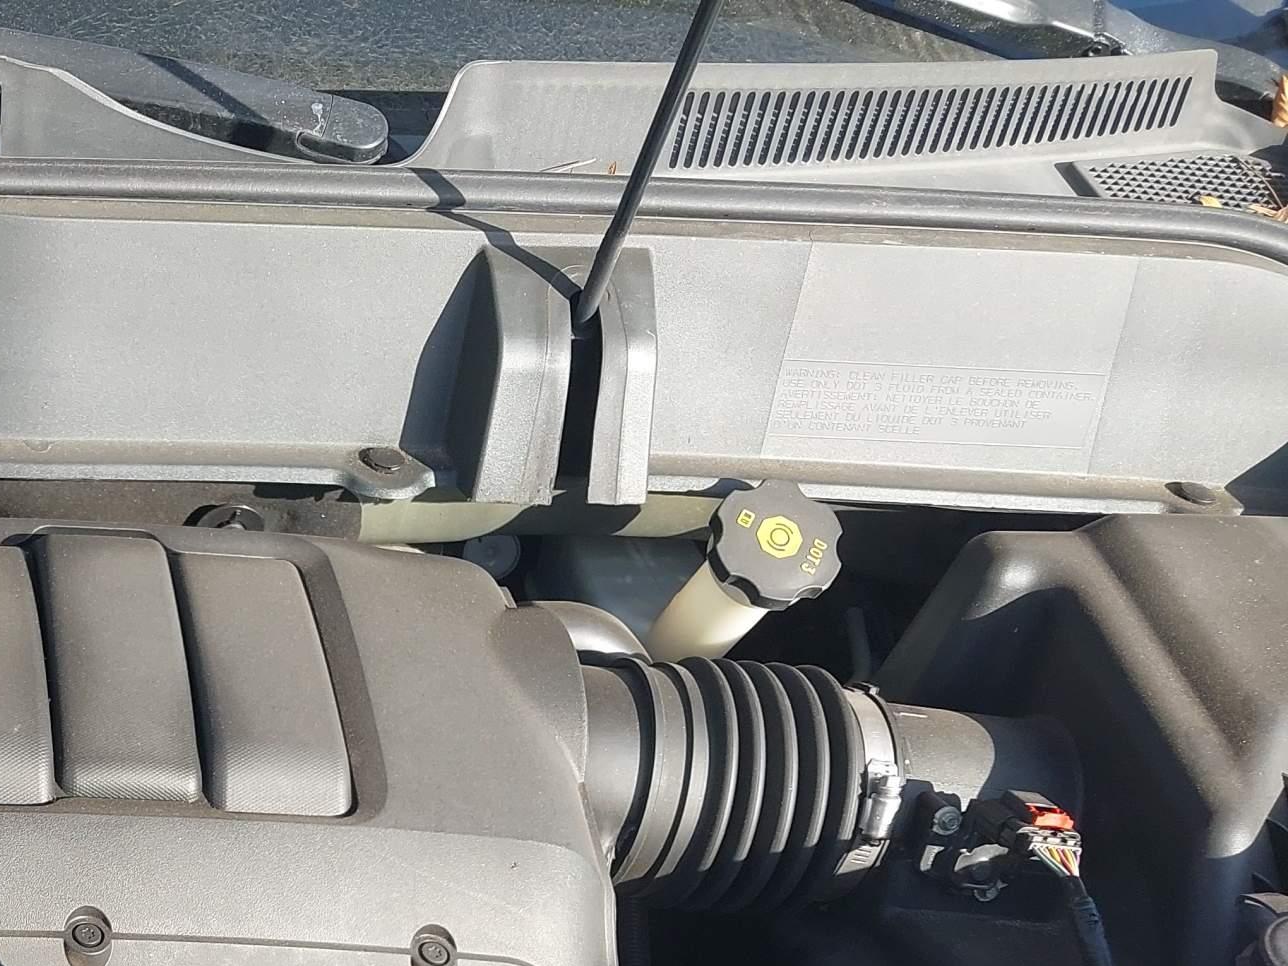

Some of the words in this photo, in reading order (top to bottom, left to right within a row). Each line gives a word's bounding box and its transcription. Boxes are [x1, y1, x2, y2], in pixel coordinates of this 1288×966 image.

[784, 368, 841, 379] WARNING:
[849, 370, 886, 381] CLEAN
[890, 372, 935, 383] FILLER
[940, 375, 962, 385] CAP
[968, 376, 1010, 387] BEFORE
[1016, 378, 1078, 391] REMOVING.
[782, 379, 804, 388] USE
[810, 380, 840, 389] ONLY
[846, 381, 867, 391] DOT
[874, 382, 882, 392] 3
[888, 383, 925, 393] FLUID
[930, 385, 959, 395] FROM
[979, 387, 1022, 398] SEALED
[777, 399, 857, 412] REMPLISSAGE
[862, 403, 898, 413] AVANT
[904, 405, 920, 414] DE
[886, 393, 943, 405] NETTOYER
[949, 397, 964, 406] LE
[1025, 400, 1041, 409] DE
[846, 412, 862, 422] DU
